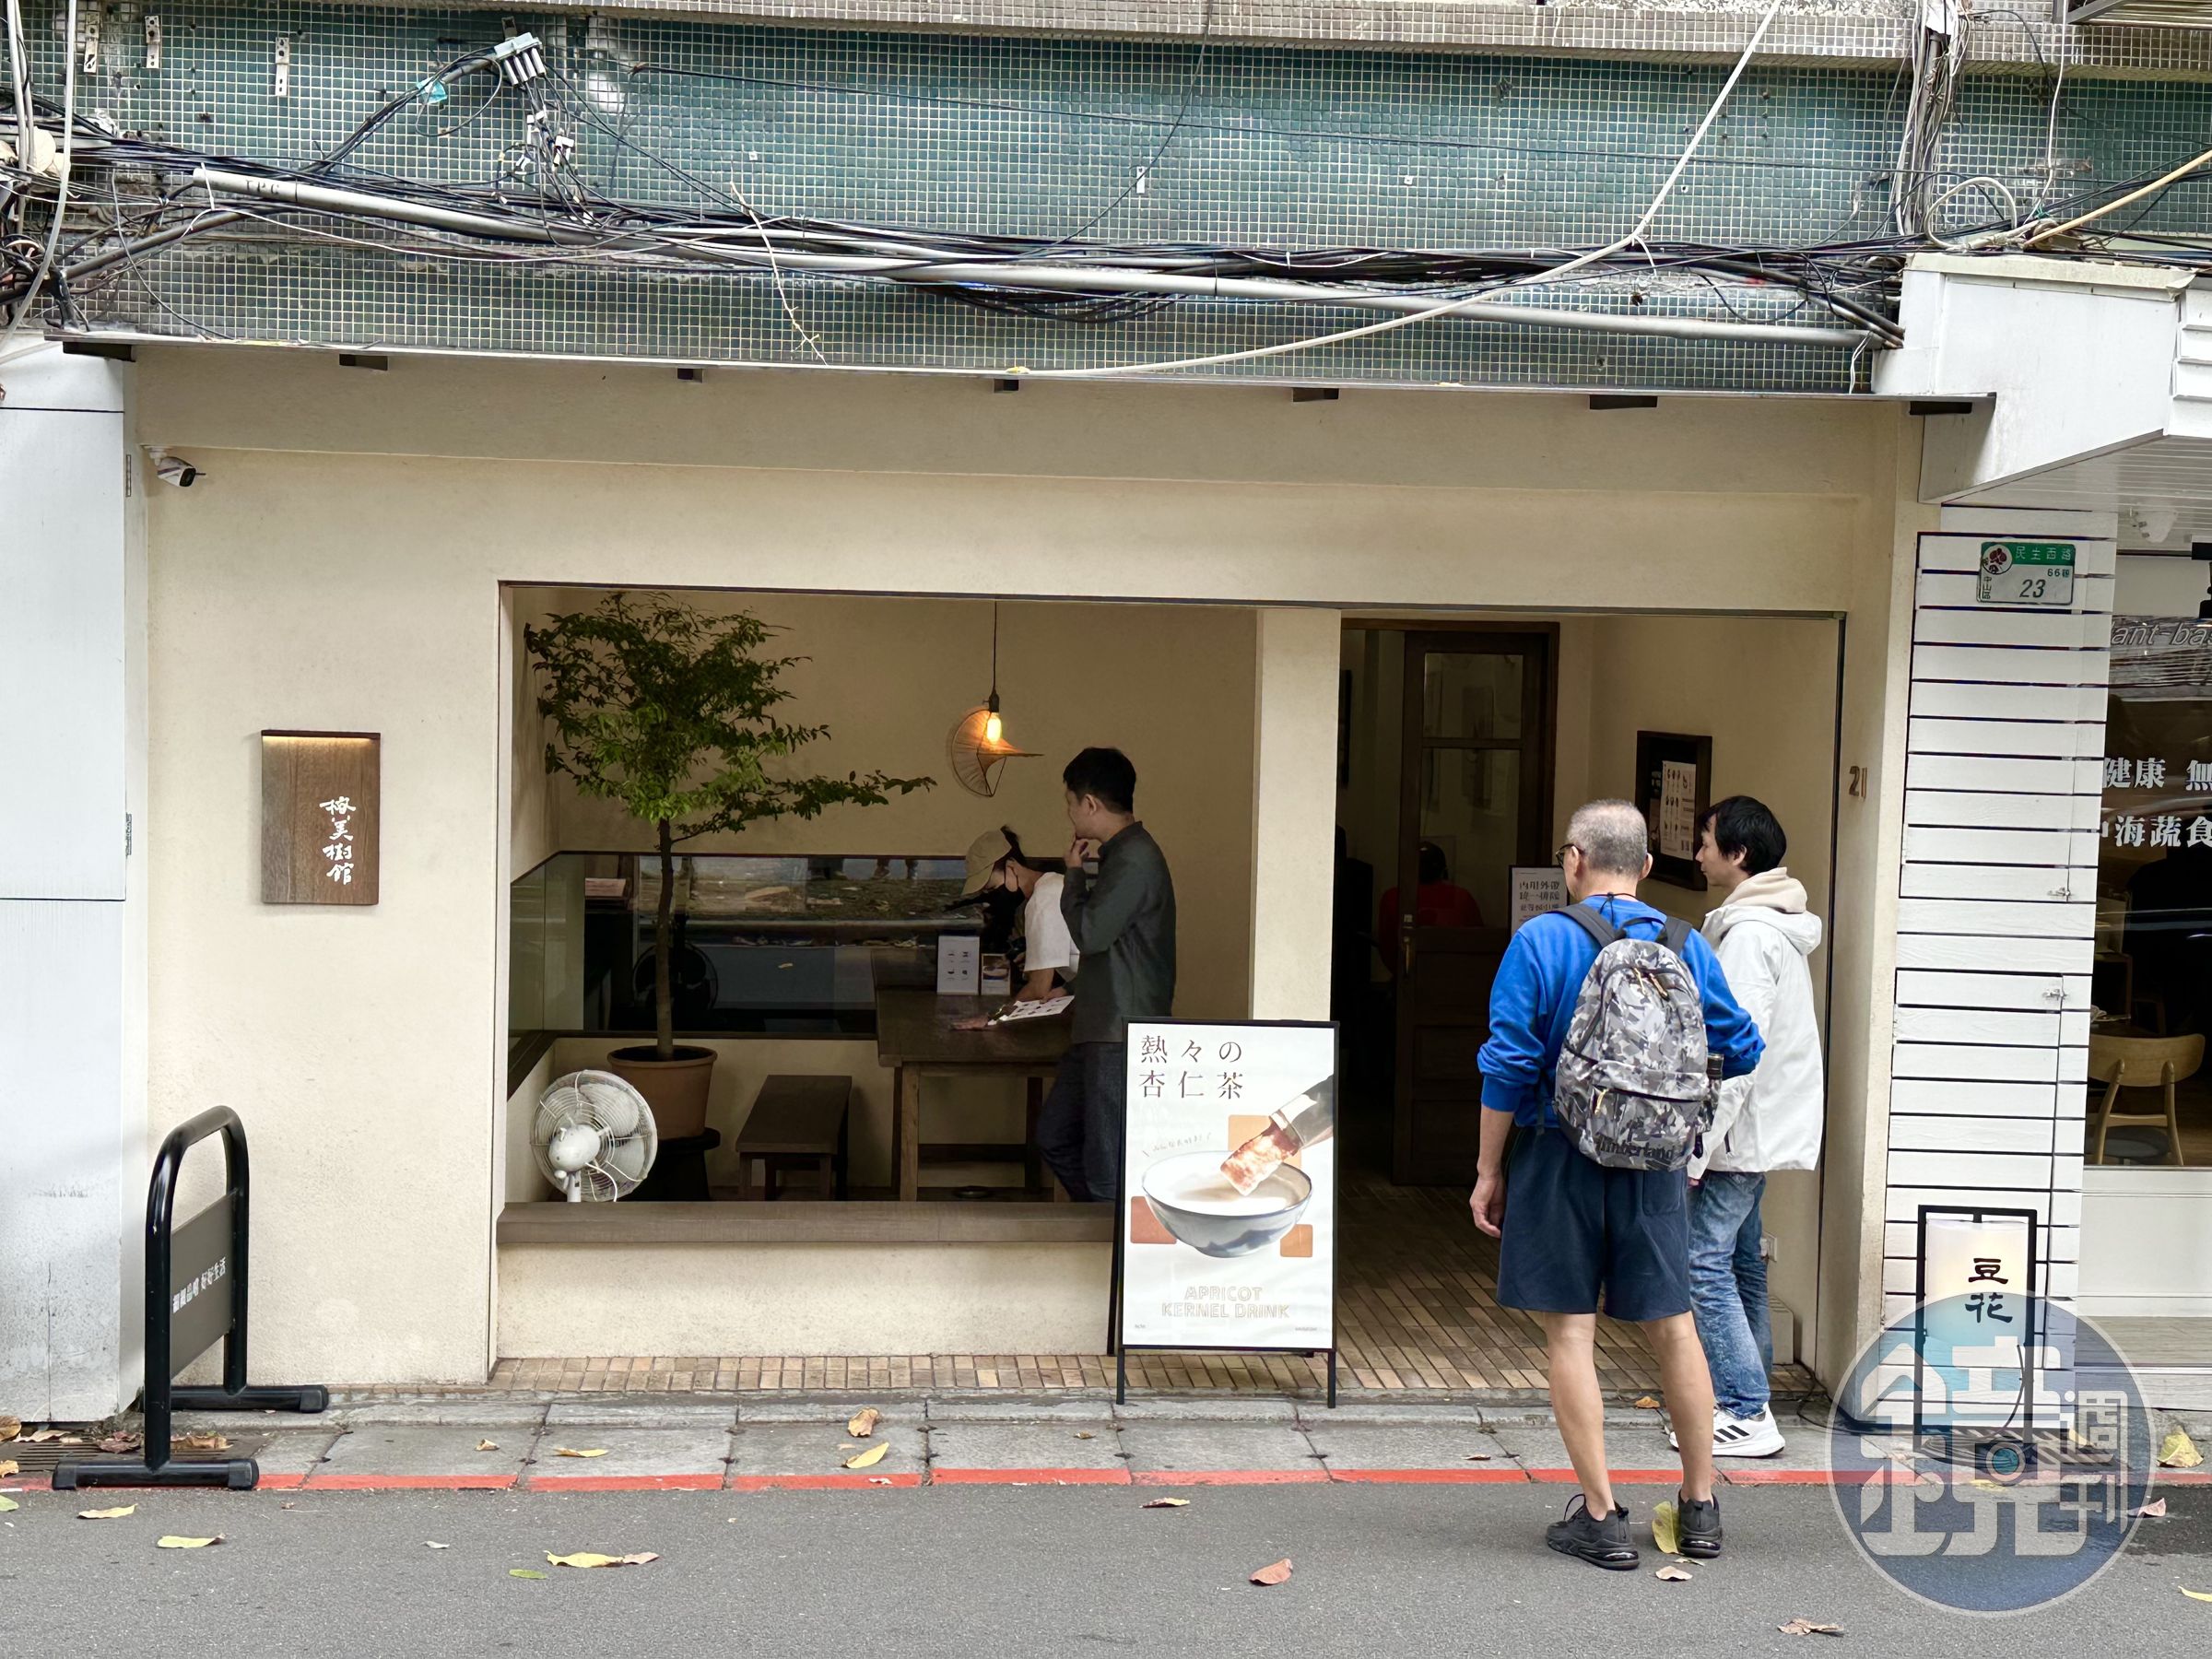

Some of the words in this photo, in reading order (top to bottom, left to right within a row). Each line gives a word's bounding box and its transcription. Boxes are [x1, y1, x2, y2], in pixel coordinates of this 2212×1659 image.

[2015, 546, 2072, 561] 民生西路
[1982, 575, 1992, 599] 中山區
[2019, 578, 2046, 598] 23
[2110, 621, 2212, 646] ant-ba
[1849, 765, 1867, 798] 21
[2102, 757, 2166, 789] 健康
[1141, 1035, 1242, 1064] 熱々の
[1139, 1069, 1243, 1100] 杏仁茶
[1183, 1286, 1263, 1301] APRICOT
[1965, 1257, 2013, 1324] 豆花
[1161, 1302, 1230, 1318] KERNEL
[1234, 1303, 1289, 1319] DRINK
